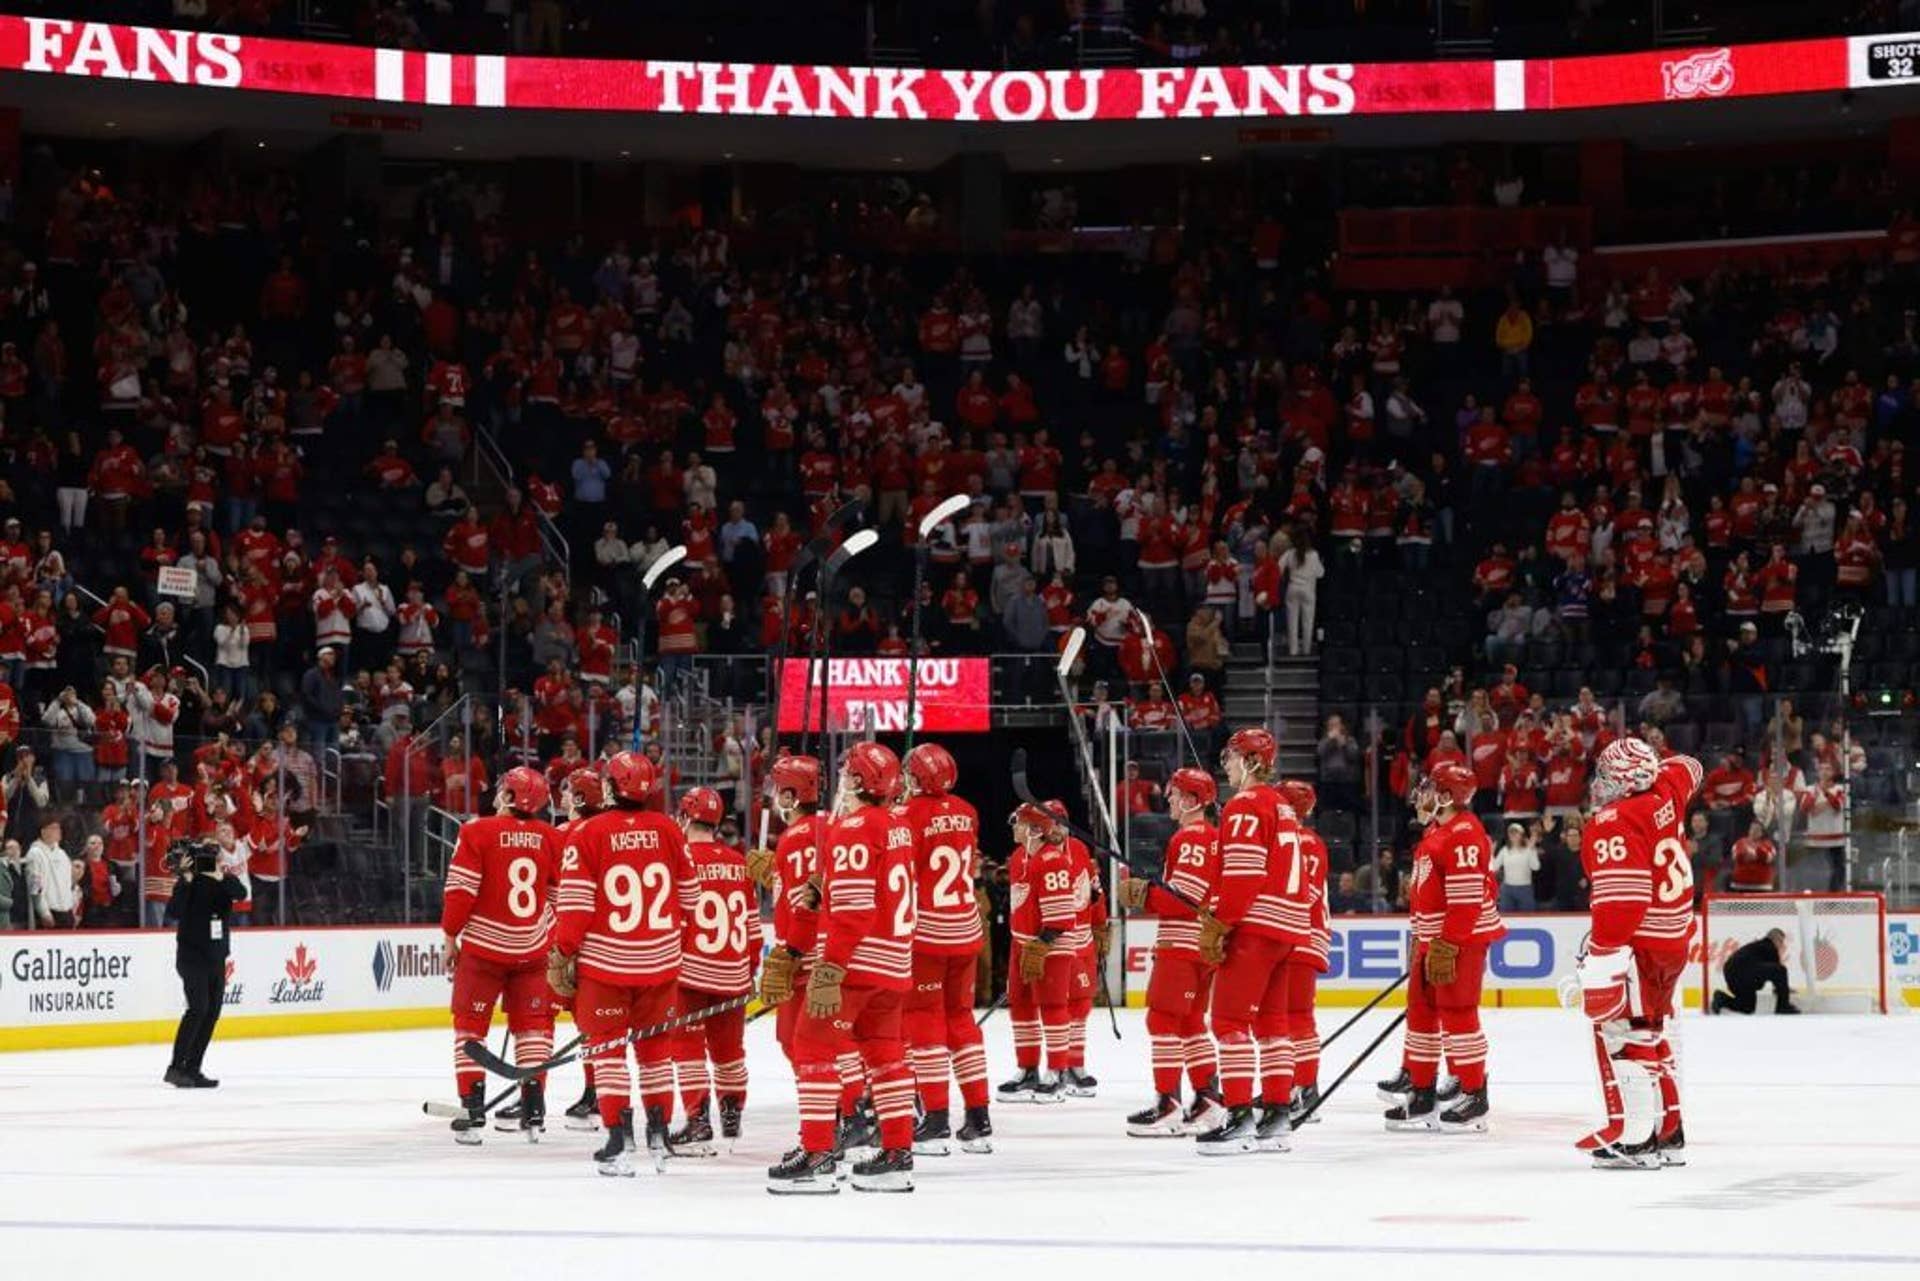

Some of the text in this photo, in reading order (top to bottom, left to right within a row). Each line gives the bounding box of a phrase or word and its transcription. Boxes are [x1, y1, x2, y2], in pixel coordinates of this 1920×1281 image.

[23, 17, 242, 88] FANS
[1888, 58, 1914, 76] 32
[647, 61, 1356, 121] THANK YOU FANS
[1228, 814, 1258, 837] 77
[610, 830, 659, 852] KASPER
[1593, 836, 1627, 863] 36
[833, 844, 869, 872] 20
[1178, 843, 1206, 867] 25
[1455, 845, 1479, 867] 18
[508, 857, 537, 918] 8
[929, 845, 975, 908] 21
[1045, 870, 1069, 890] 88
[604, 862, 673, 933] 92
[888, 863, 918, 936] 2
[695, 891, 748, 954] 93
[12, 949, 131, 986] Gallagher
[29, 991, 115, 1012] INSURANCE
[269, 979, 324, 1004] Labatt
